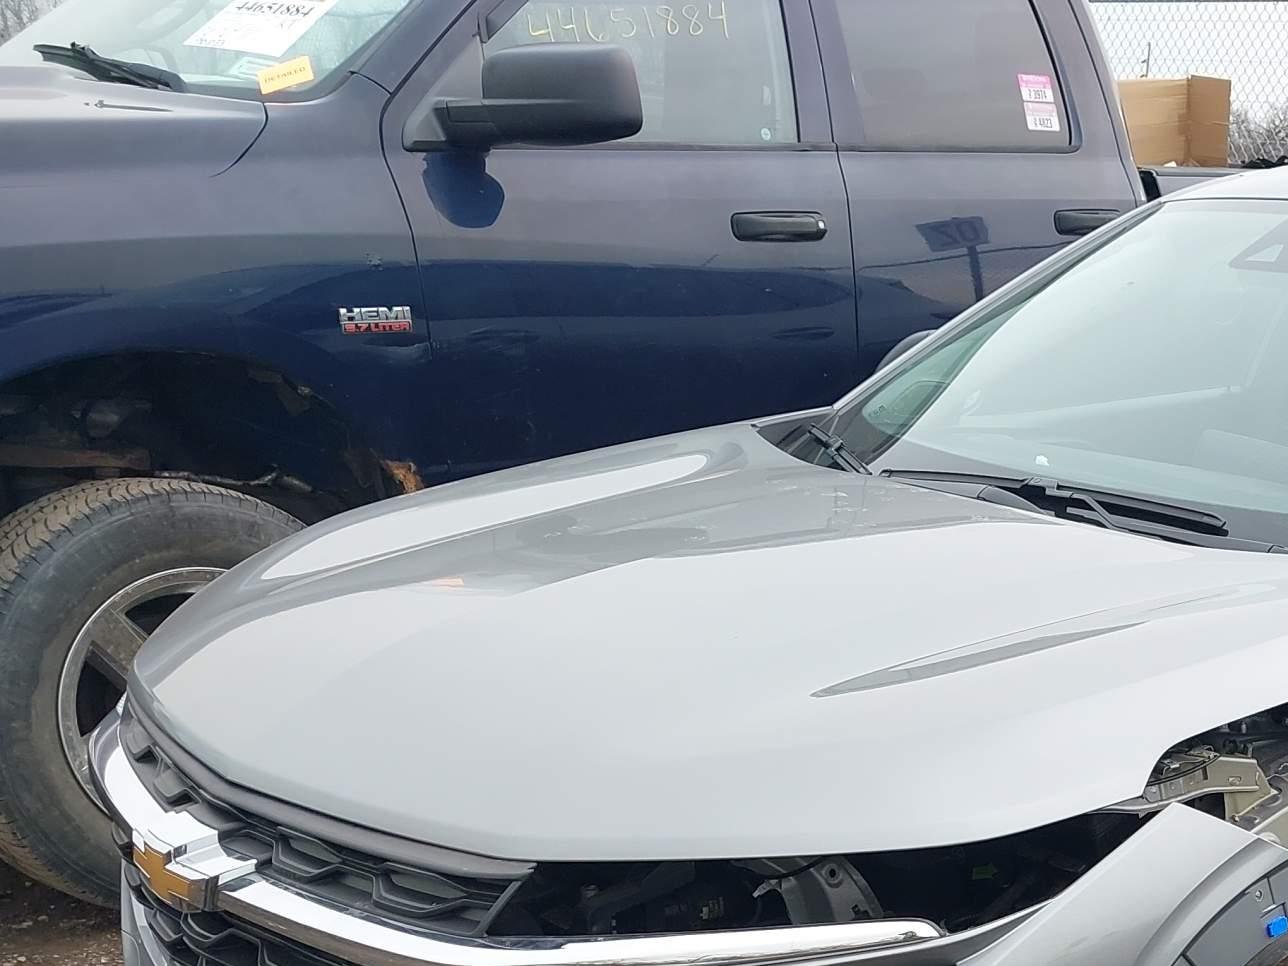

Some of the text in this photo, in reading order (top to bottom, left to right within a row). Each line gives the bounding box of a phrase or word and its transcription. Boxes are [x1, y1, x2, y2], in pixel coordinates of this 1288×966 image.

[236, 1, 316, 17] 44651884
[527, 0, 729, 43] 44651884
[339, 306, 410, 321] HEMI
[370, 322, 410, 332] LITER
